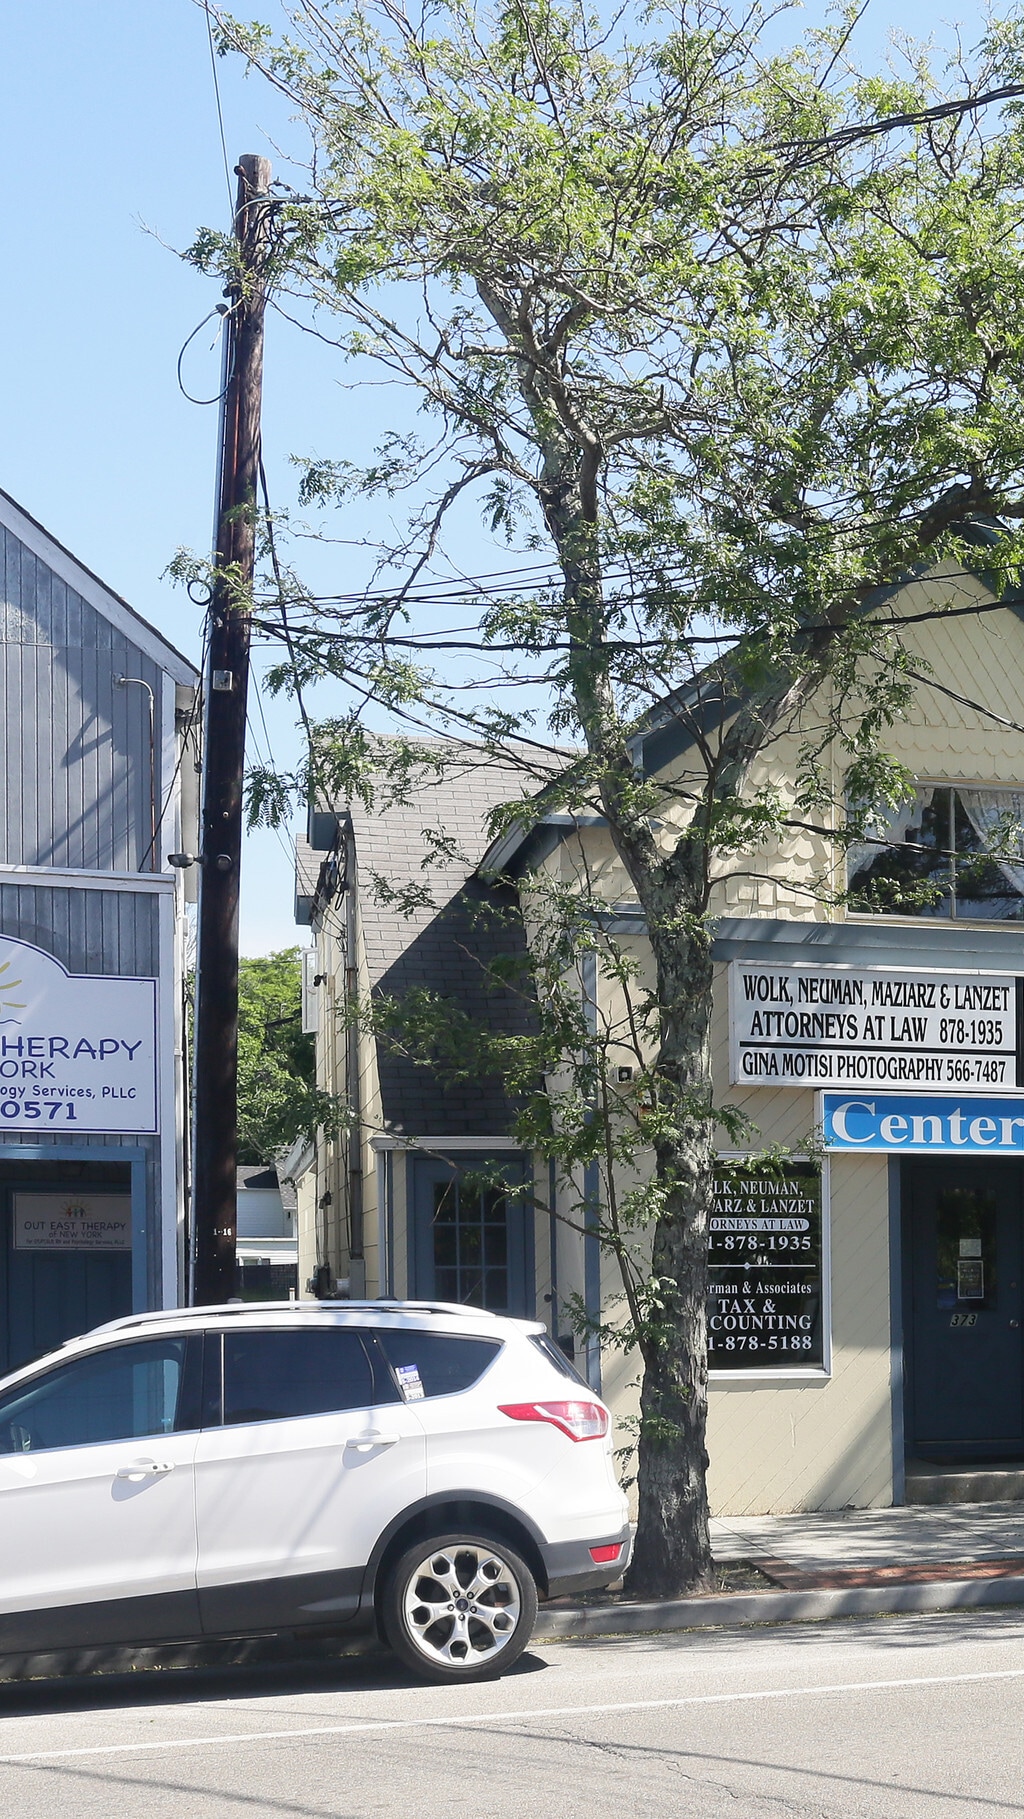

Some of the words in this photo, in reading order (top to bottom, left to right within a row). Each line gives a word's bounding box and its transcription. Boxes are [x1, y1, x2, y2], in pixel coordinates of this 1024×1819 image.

[743, 975, 793, 1006] WOLK,
[798, 977, 867, 1010] NEUMAN,
[872, 981, 936, 1008] MAZIARZ
[940, 984, 950, 1009] &
[955, 985, 1009, 1011] LANZET
[750, 1010, 858, 1040] ATTORNEYS
[863, 1015, 886, 1040] AT
[890, 1016, 928, 1042] LAW
[940, 1018, 1003, 1045] 878-1935
[743, 1051, 779, 1076] GINA
[782, 1053, 832, 1077] MOTISI
[837, 1055, 943, 1080] PHOTOGRAPHY
[946, 1059, 1006, 1083] 566-7487
[32, 1085, 96, 1099] Services,
[102, 1086, 137, 1099] PLLC
[713, 1181, 737, 1196] LK,
[740, 1181, 803, 1198] NEUMAN,
[712, 1199, 742, 1213] ARZ
[746, 1199, 756, 1213] &
[761, 1199, 815, 1213] LANZET
[24, 1221, 45, 1230] OUT
[50, 1222, 76, 1230] EAST
[82, 1222, 127, 1231] THERAPY
[711, 1219, 757, 1230] ORNEYS
[761, 1220, 775, 1230] AT
[780, 1220, 804, 1230] LAW
[708, 1236, 811, 1250] 1-878-1935
[742, 1281, 751, 1294] &
[756, 1281, 812, 1294] Associates
[718, 1299, 756, 1313] TAX
[762, 1299, 776, 1313] &
[708, 1315, 812, 1330] COUNTING
[951, 1315, 976, 1326] 373
[707, 1336, 812, 1350] 1-878-5188
